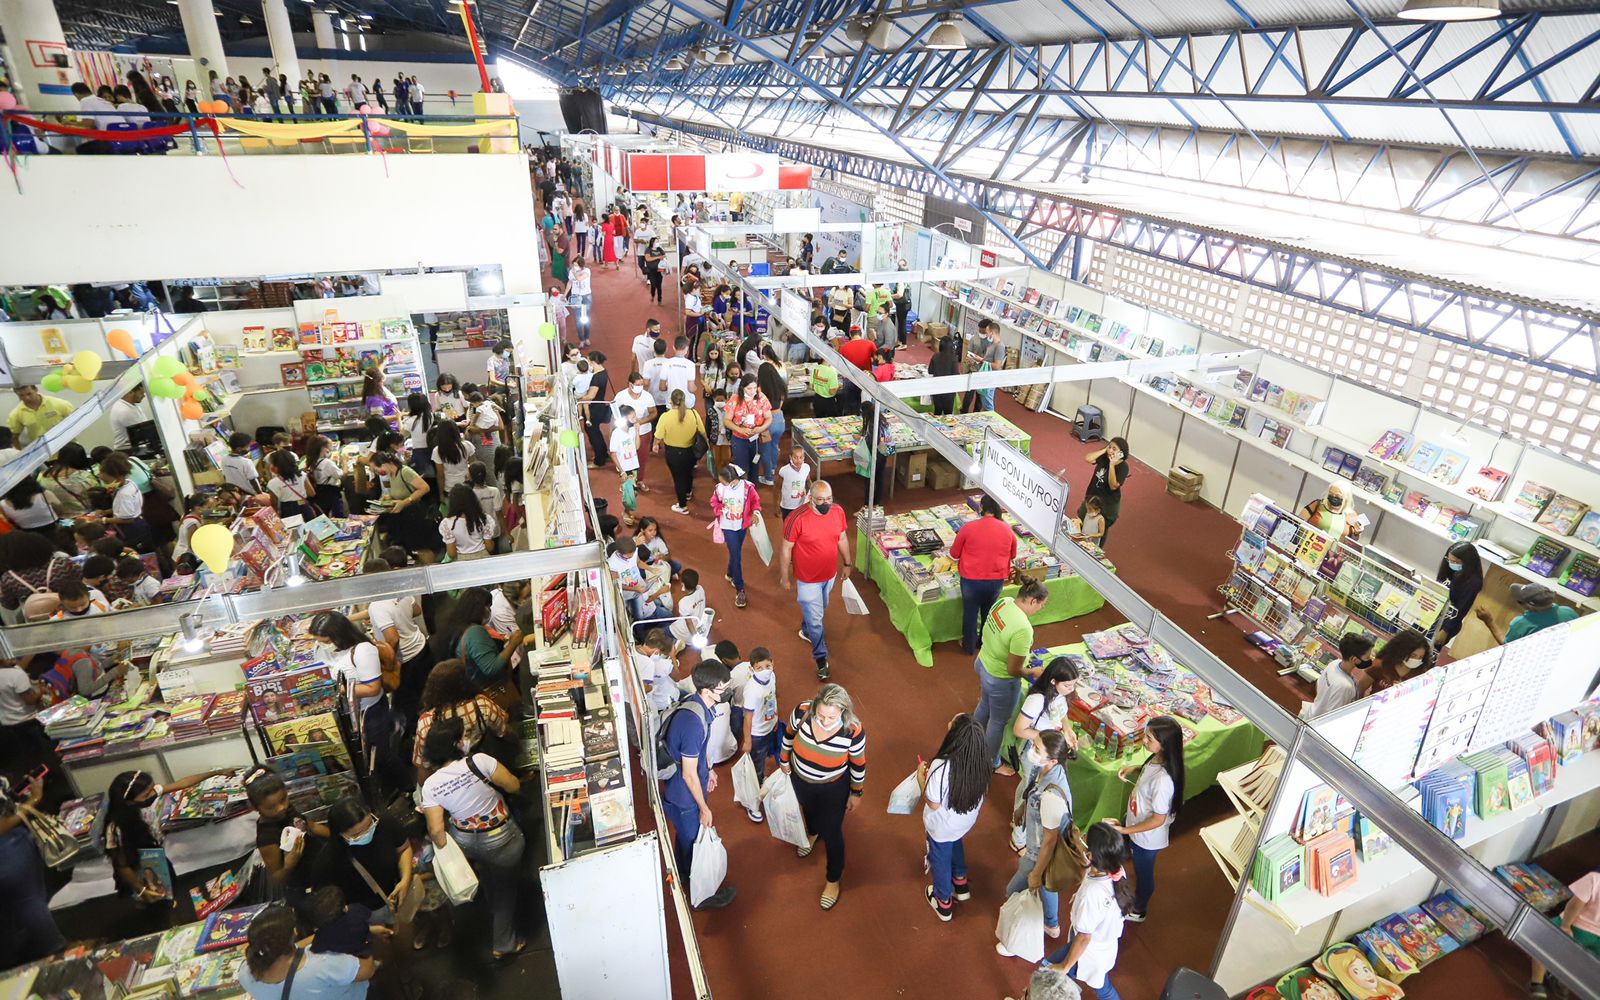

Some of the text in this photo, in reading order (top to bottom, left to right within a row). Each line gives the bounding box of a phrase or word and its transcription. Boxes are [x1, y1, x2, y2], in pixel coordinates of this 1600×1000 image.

[987, 445, 1060, 513] NILSON LIVROS
[1002, 476, 1033, 509] DESAFIO
